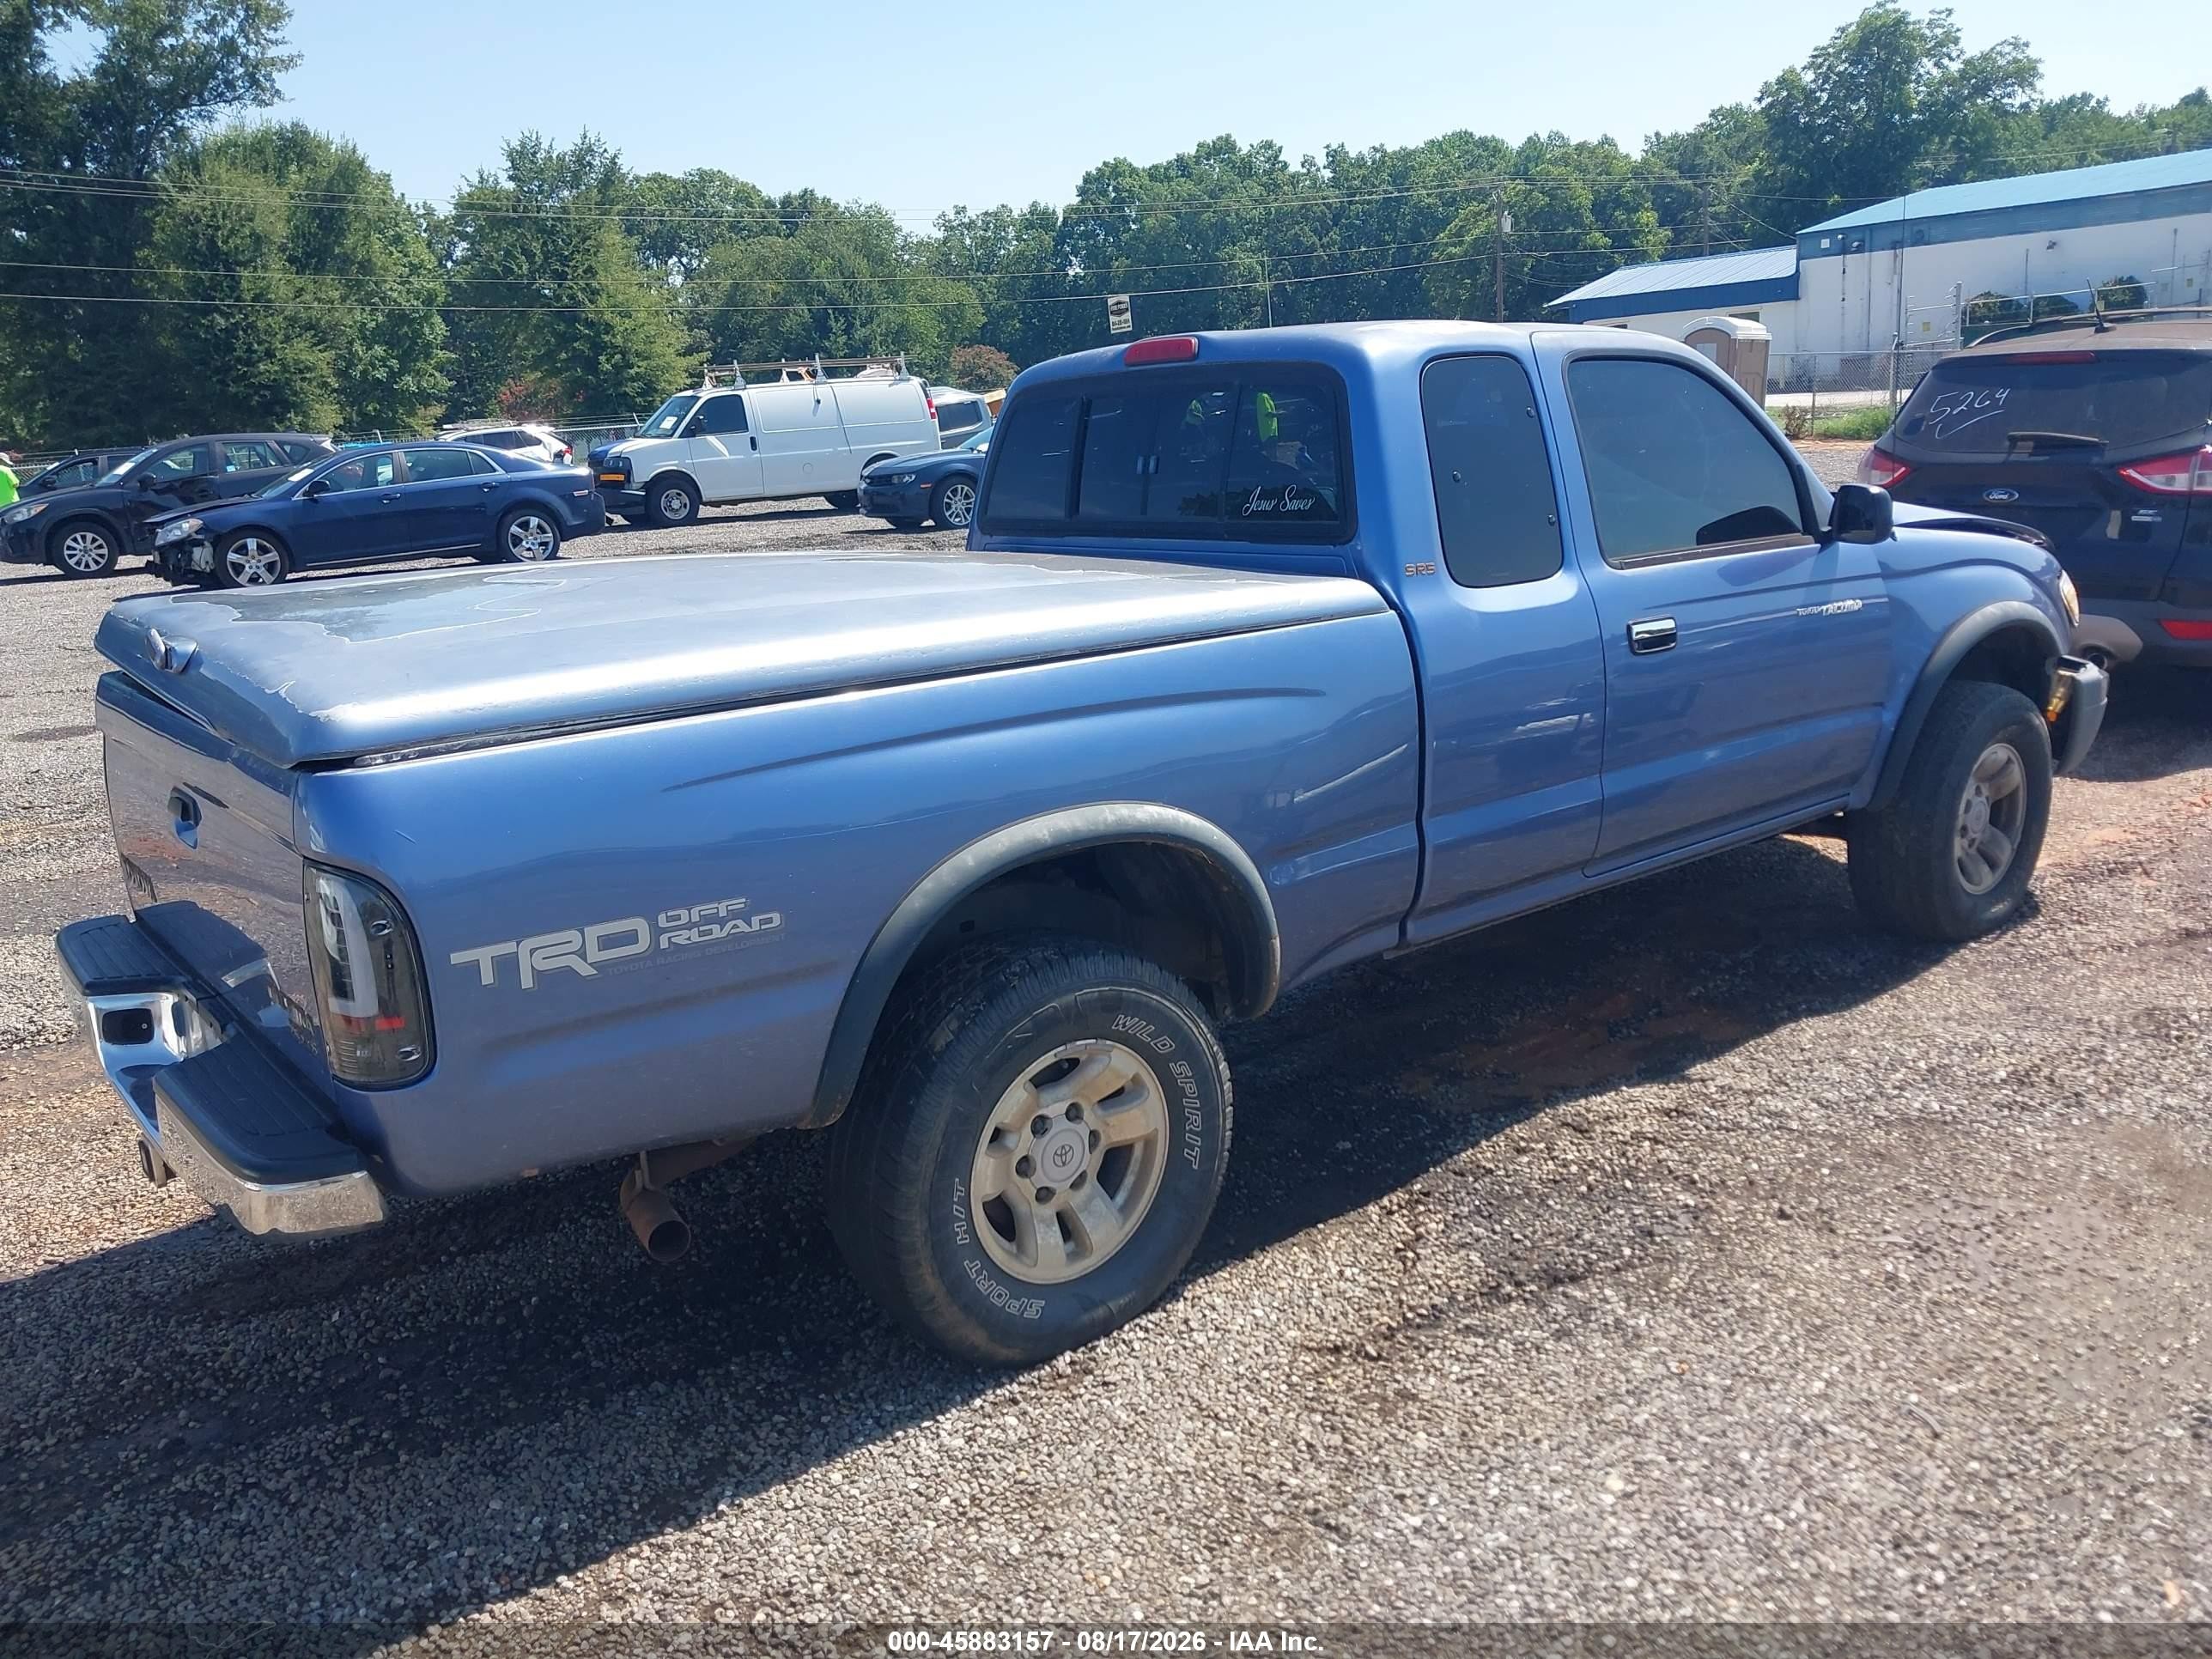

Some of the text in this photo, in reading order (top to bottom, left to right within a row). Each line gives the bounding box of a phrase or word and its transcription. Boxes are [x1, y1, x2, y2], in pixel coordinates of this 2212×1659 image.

[1929, 388, 2011, 425] 5264
[1242, 484, 1316, 516] Jesus Saves
[450, 896, 749, 990] TRD OFF
[659, 911, 782, 950] ROAD
[607, 955, 653, 976] TOYOTA
[1111, 1014, 1202, 1170] WILD SPIRIT
[953, 1178, 1046, 1320] SPORT H/T
